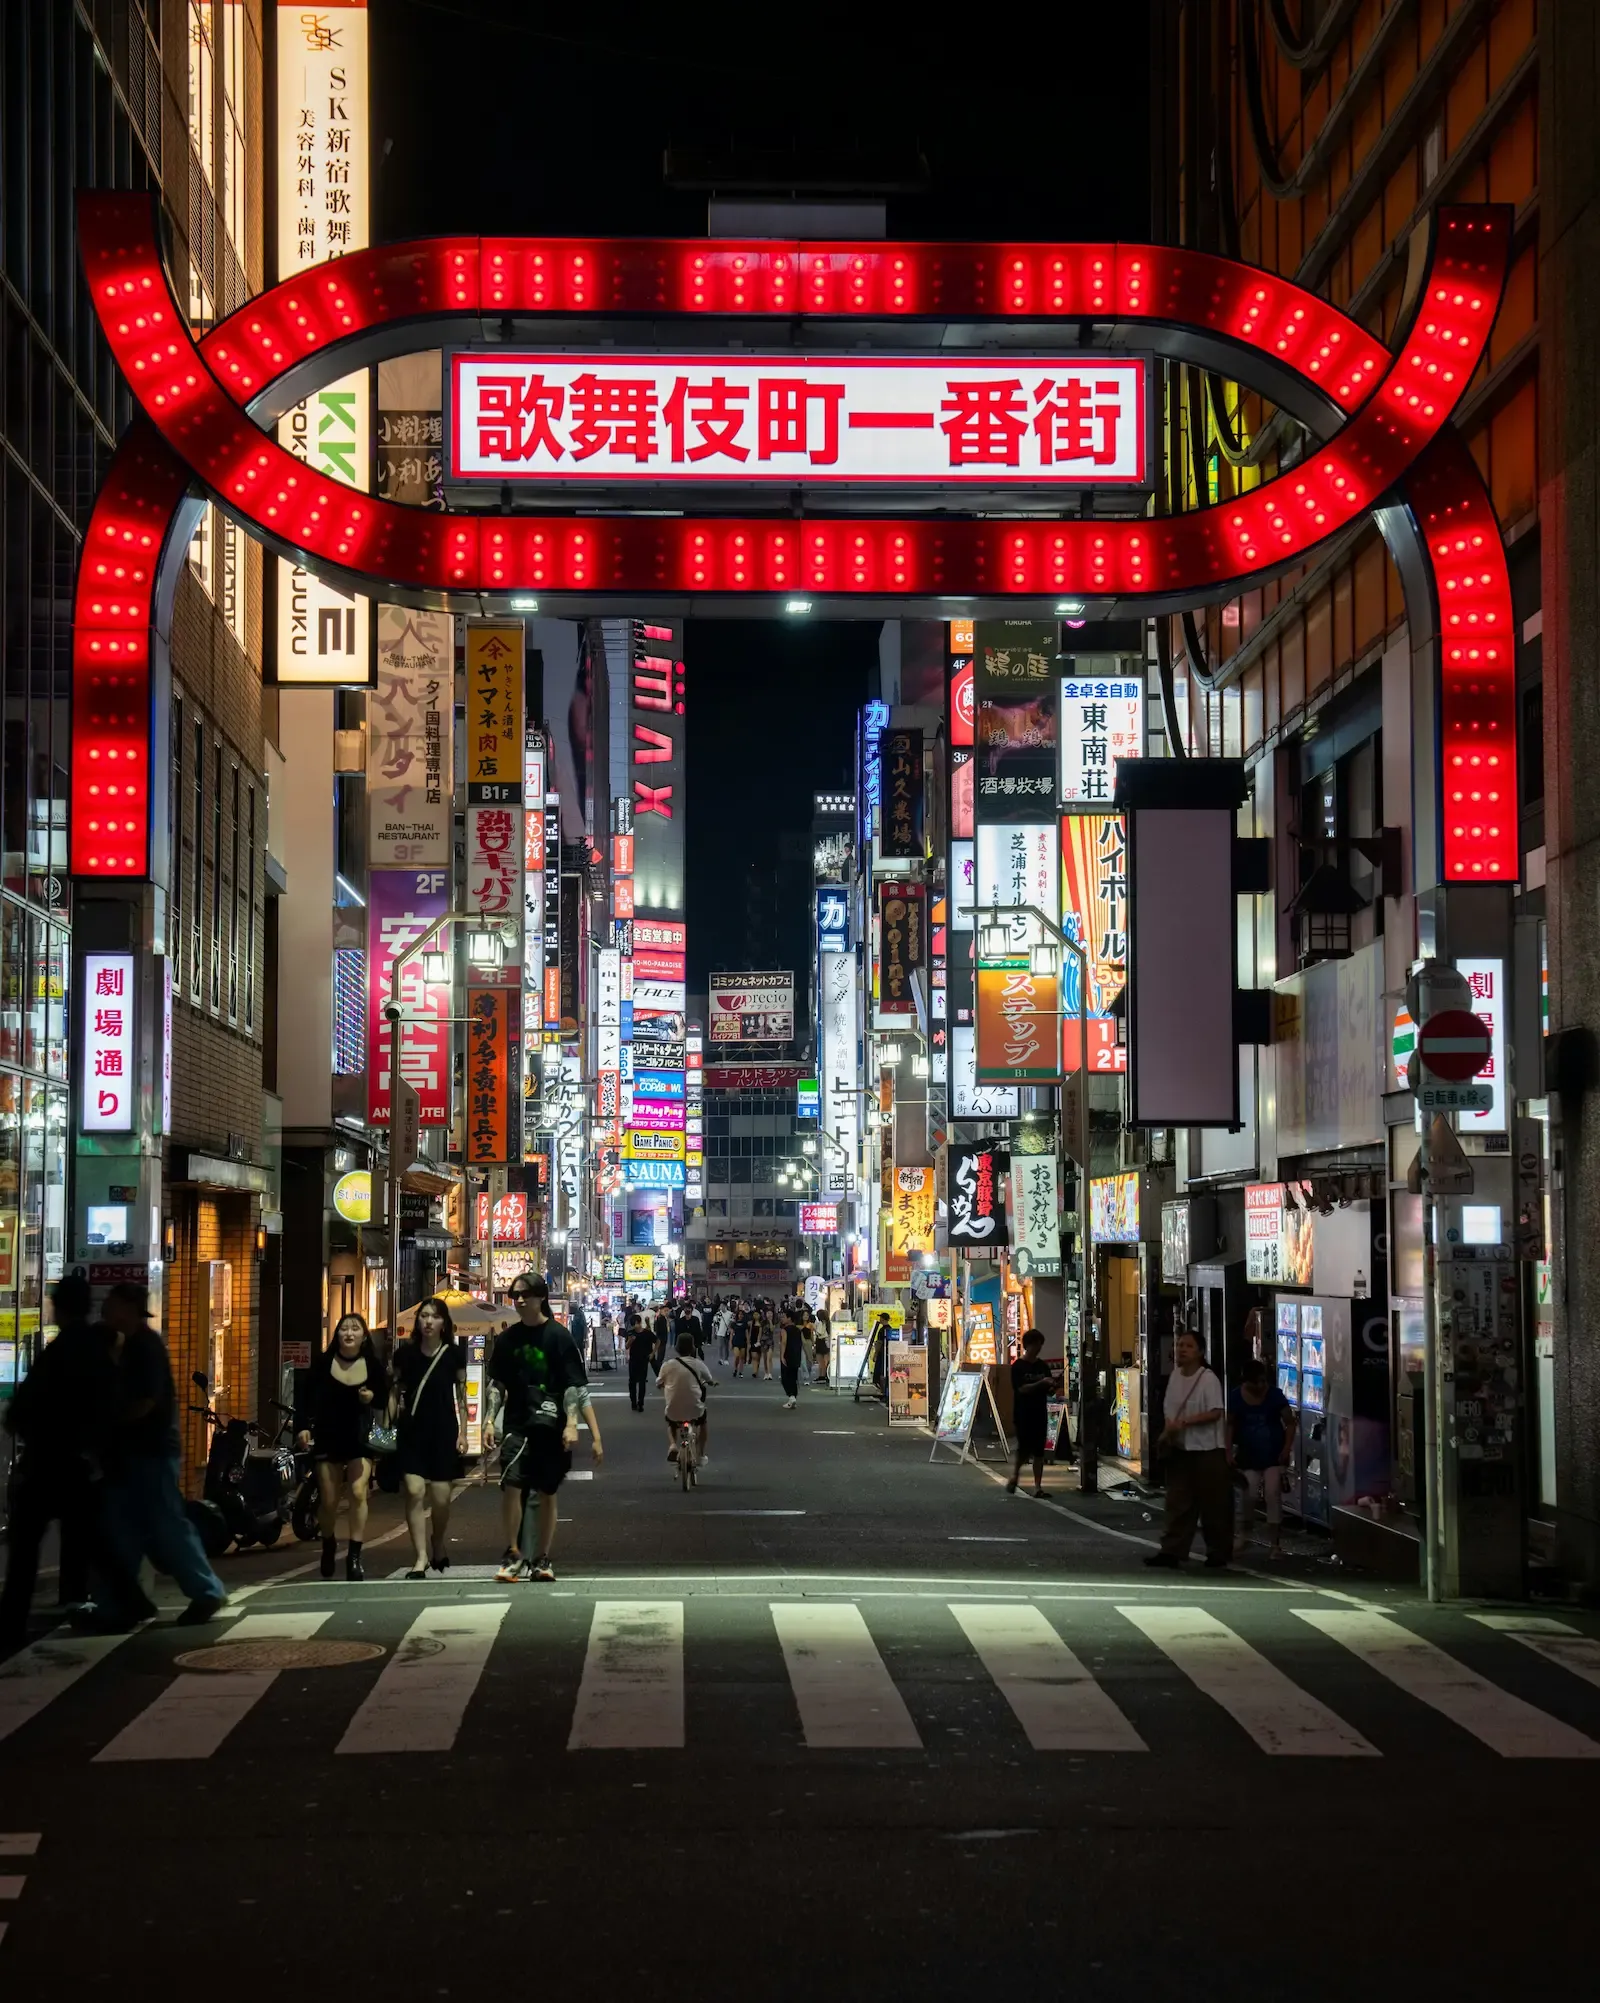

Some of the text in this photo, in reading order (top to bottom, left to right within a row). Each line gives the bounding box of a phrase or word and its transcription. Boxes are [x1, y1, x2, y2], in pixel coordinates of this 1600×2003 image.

[325, 66, 351, 260] SK新宿歌舞
[476, 374, 1121, 466] 歌舞伎町一番街
[953, 660, 965, 669] 4F
[1064, 683, 1139, 698] 全卓全自動
[425, 679, 441, 804] タイ国料理専門店
[953, 752, 968, 763] 3F
[1081, 703, 1108, 799] 東南荘
[481, 785, 509, 800] B1F
[980, 777, 1054, 795] 酒場牧場
[1065, 788, 1078, 799] 3F
[385, 823, 434, 831] BAN-THAI
[377, 832, 440, 841] RESTAURANT
[472, 809, 520, 926] 熟女キャバク
[416, 873, 445, 894] 2F
[889, 886, 916, 896] 麻雀
[1010, 832, 1028, 942] 芝浦ホルモン
[633, 928, 683, 944] 全店営業中
[379, 911, 439, 1091] 安楽亭
[1000, 974, 1040, 1065] ステップ
[95, 969, 124, 1117] 劇場通り
[719, 1069, 808, 1079] ゴールドラッシュ
[1015, 1069, 1028, 1078] B1
[736, 1079, 780, 1087] ハンバーグ
[956, 1084, 968, 1114] 一番街
[1423, 1091, 1488, 1106] 自転車を除く
[372, 1107, 445, 1118] ANUTEI
[995, 1104, 1017, 1115] B1F
[634, 1134, 673, 1148] GAME PANIC
[629, 1163, 684, 1181] SAUNA
[899, 1172, 923, 1185] 新宿
[976, 1152, 993, 1216] 東京豚骨
[1015, 1164, 1023, 1201] HIROSHIMA
[1029, 1163, 1056, 1249] お好み焼き
[898, 1193, 916, 1250] まっちゃん
[1037, 1263, 1060, 1273] B1F
